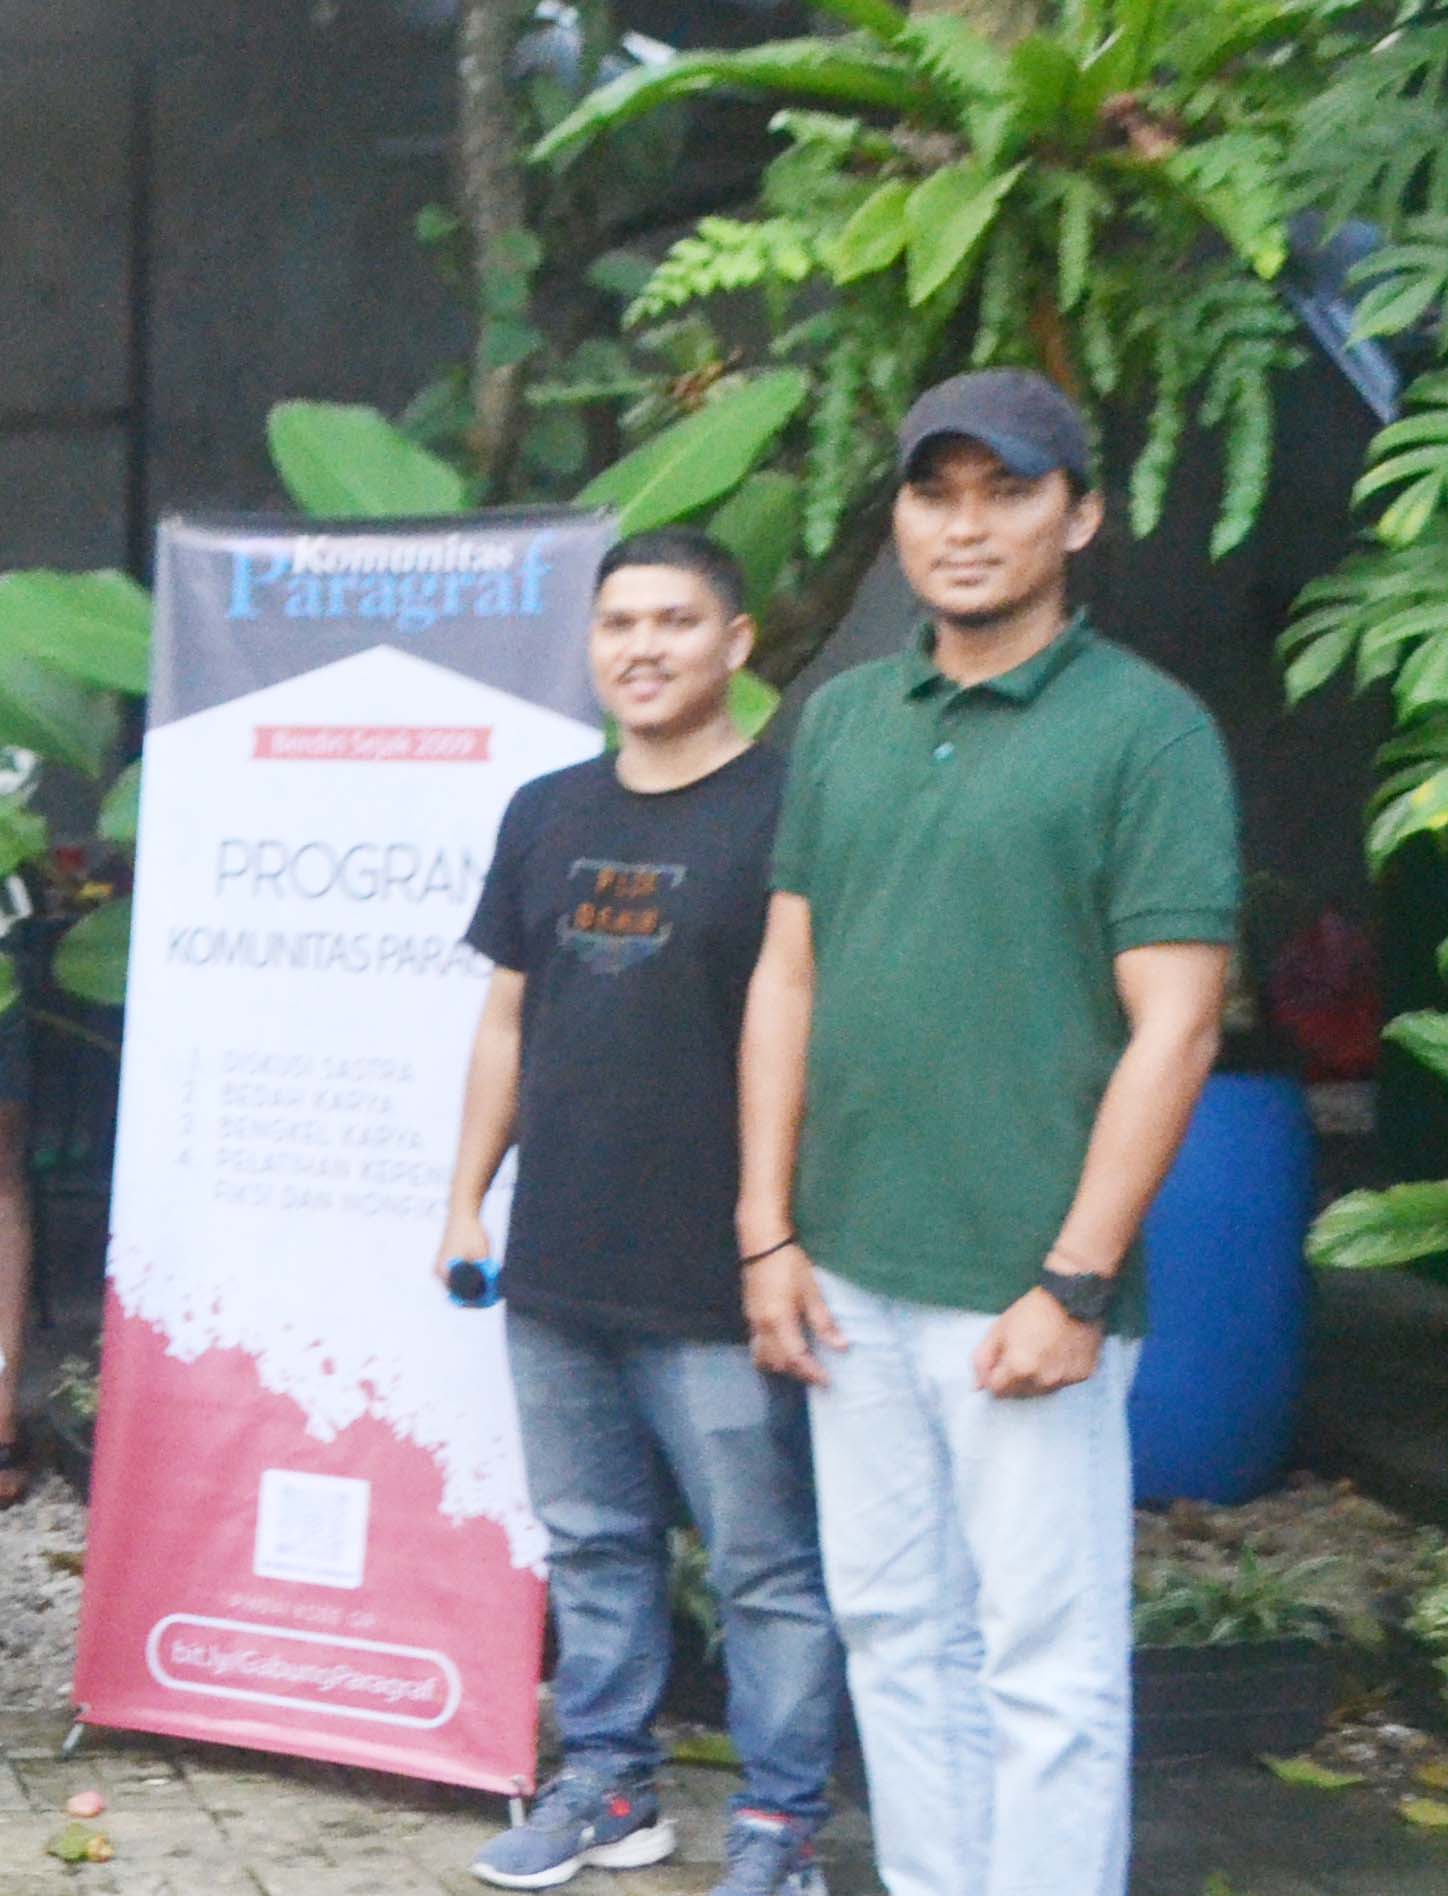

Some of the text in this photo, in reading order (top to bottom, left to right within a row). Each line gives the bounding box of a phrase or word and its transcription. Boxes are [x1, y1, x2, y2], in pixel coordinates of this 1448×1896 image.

[291, 532, 514, 574] Komunitas
[226, 530, 557, 632] Paragraf
[167, 926, 370, 974] KOMUNITAS
[320, 1056, 416, 1085] SASTRA
[221, 1081, 305, 1109] BEDAH
[312, 1086, 395, 1115] KARYA
[341, 1121, 426, 1153] KARYA
[280, 1184, 334, 1211] DAN
